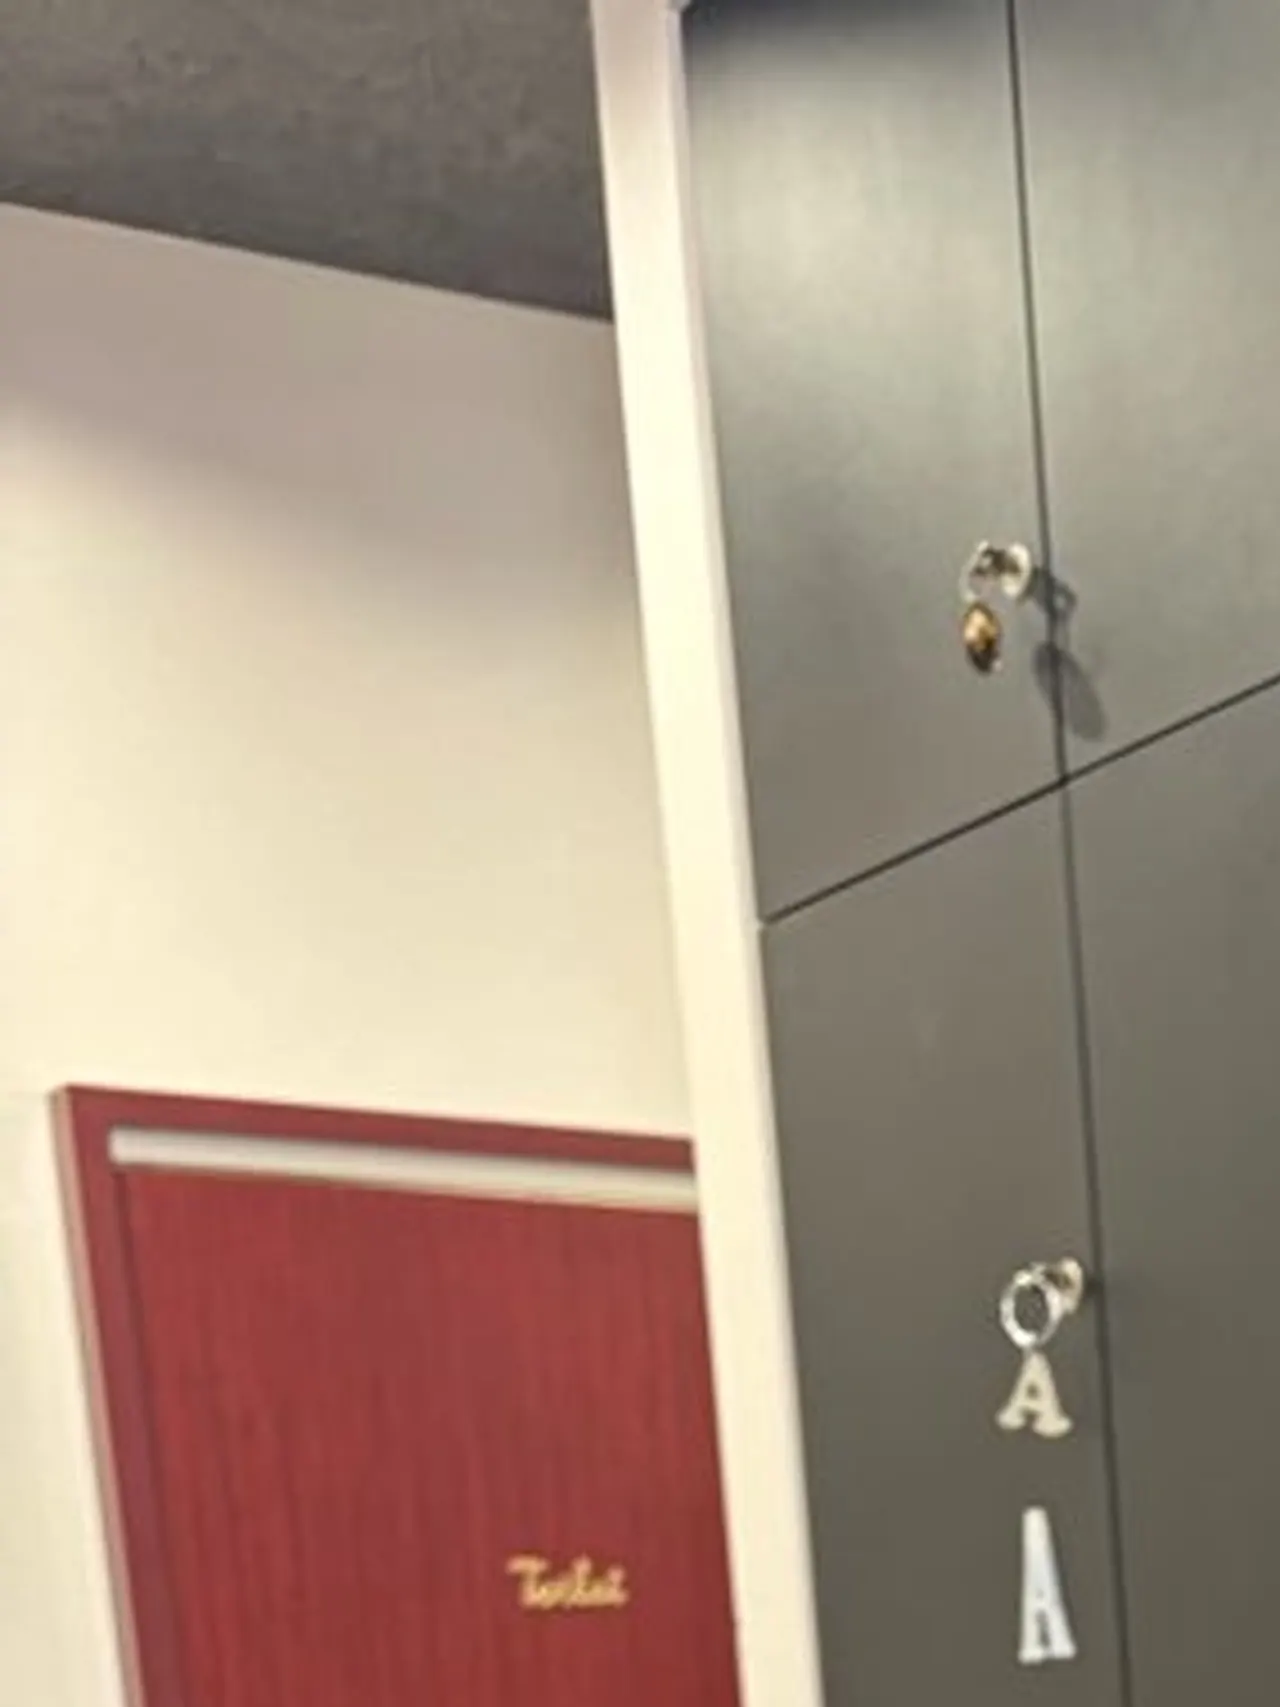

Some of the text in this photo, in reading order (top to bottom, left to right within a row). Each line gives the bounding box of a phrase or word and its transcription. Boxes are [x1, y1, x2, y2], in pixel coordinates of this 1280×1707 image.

[996, 1348, 1073, 1439] A
[504, 1552, 630, 1612] Toilet
[1017, 1505, 1077, 1664] A
